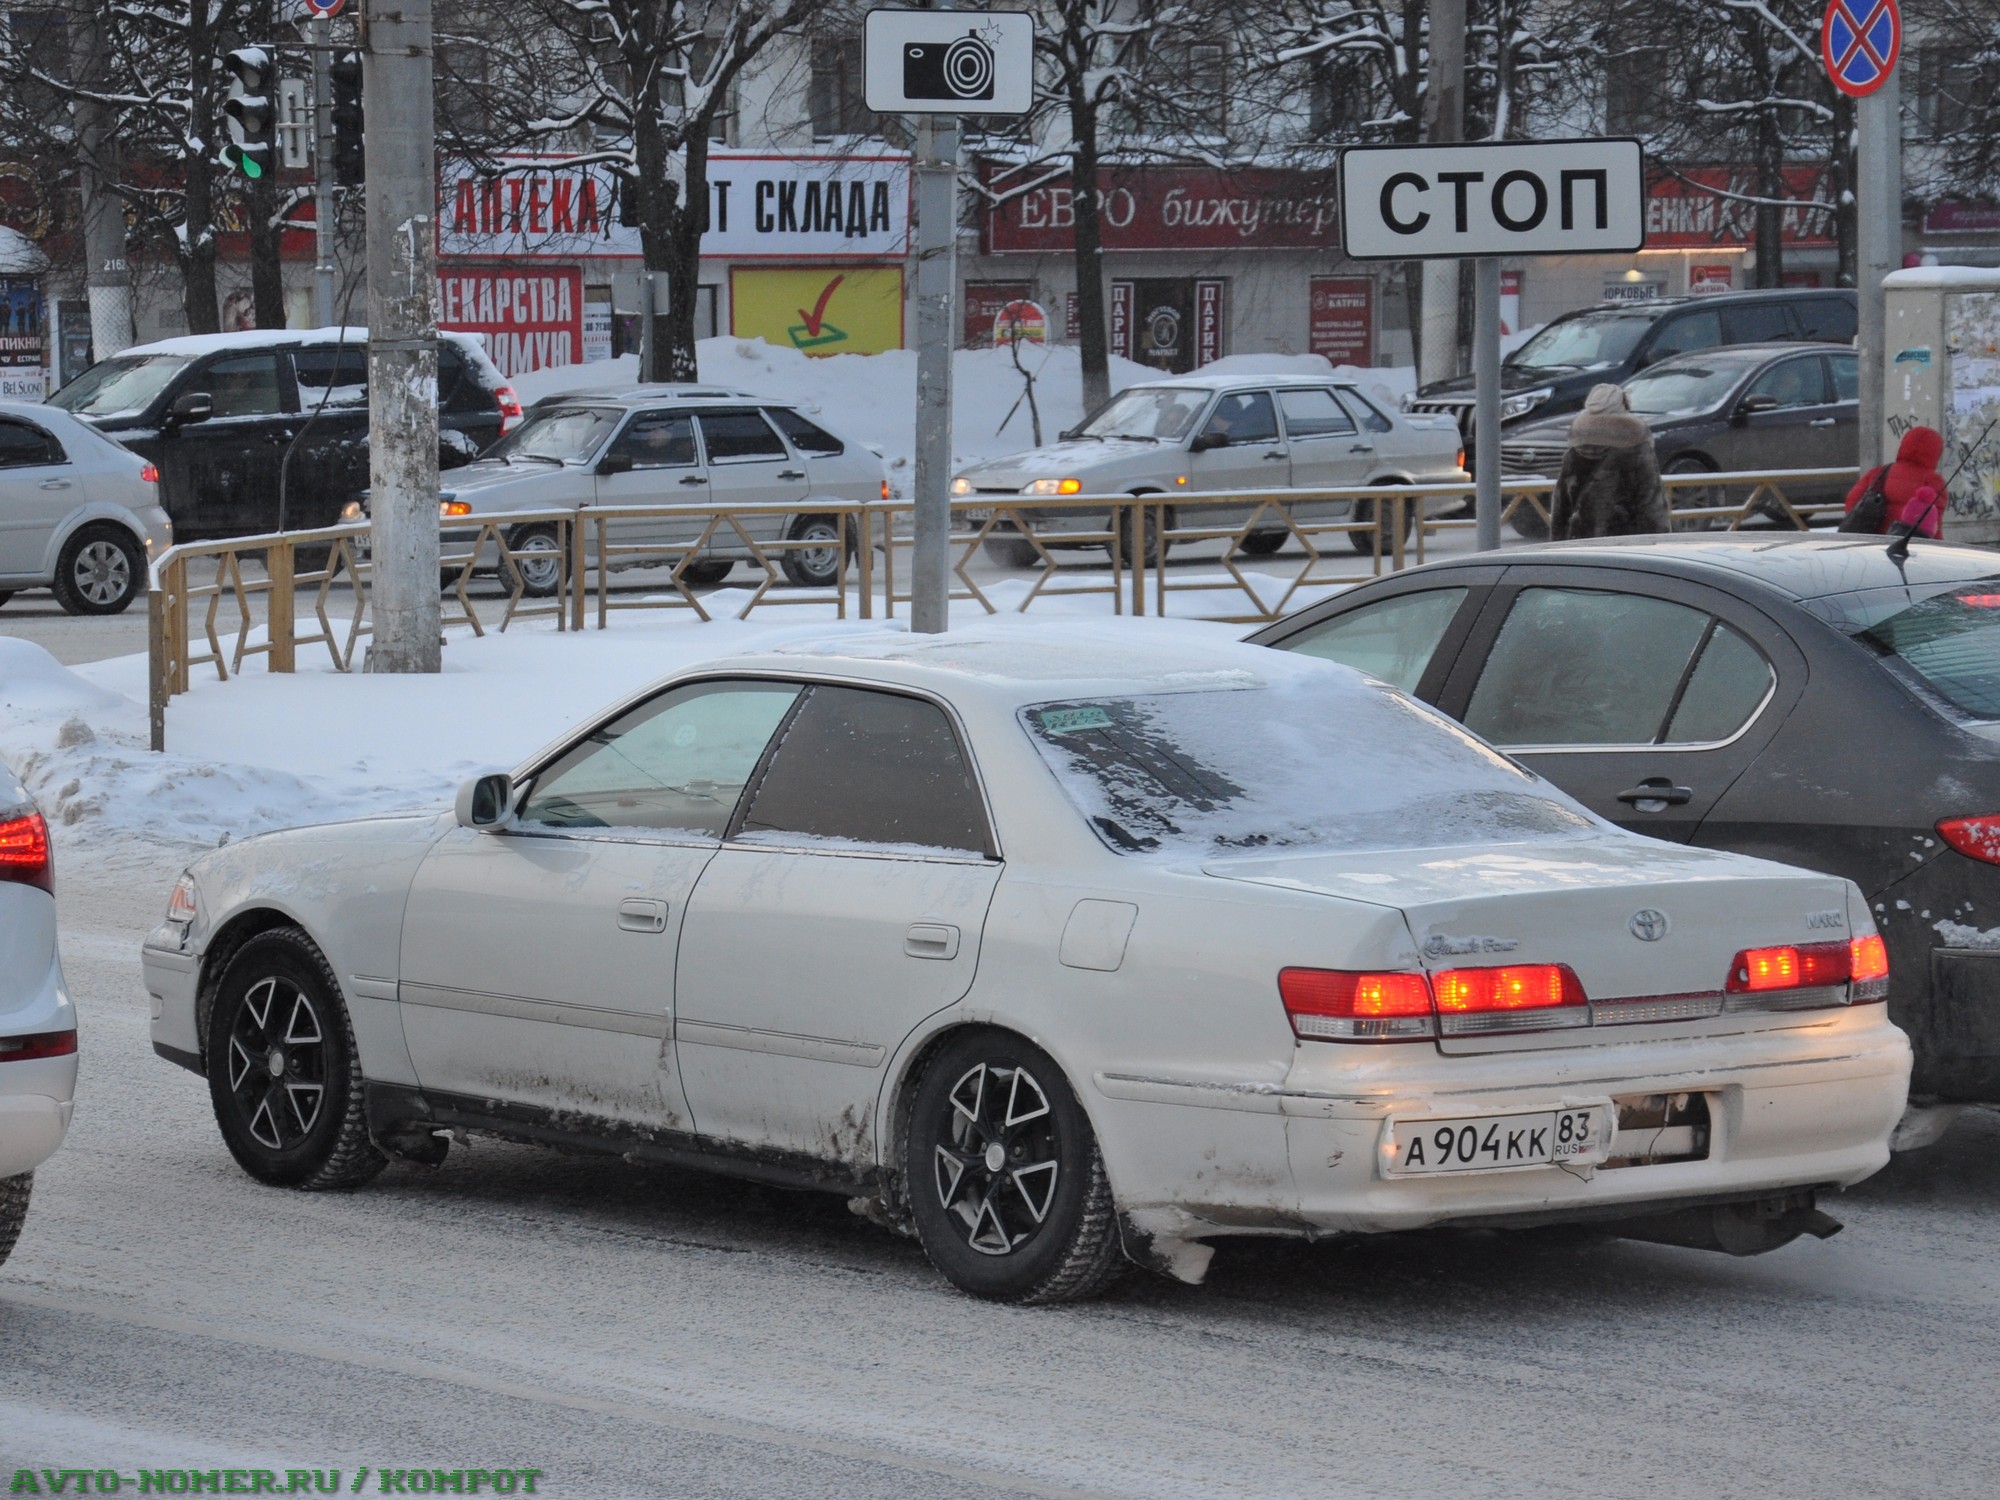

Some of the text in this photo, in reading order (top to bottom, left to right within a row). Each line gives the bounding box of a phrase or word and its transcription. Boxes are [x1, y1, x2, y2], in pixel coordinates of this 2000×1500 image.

[454, 178, 600, 234] АПТЕКА
[755, 179, 890, 238] СКЛАДА
[1379, 168, 1609, 235] СТОП
[1404, 1122, 1549, 1167] А904КК
[1555, 1142, 1578, 1156] RUS
[1557, 1111, 1591, 1144] 83
